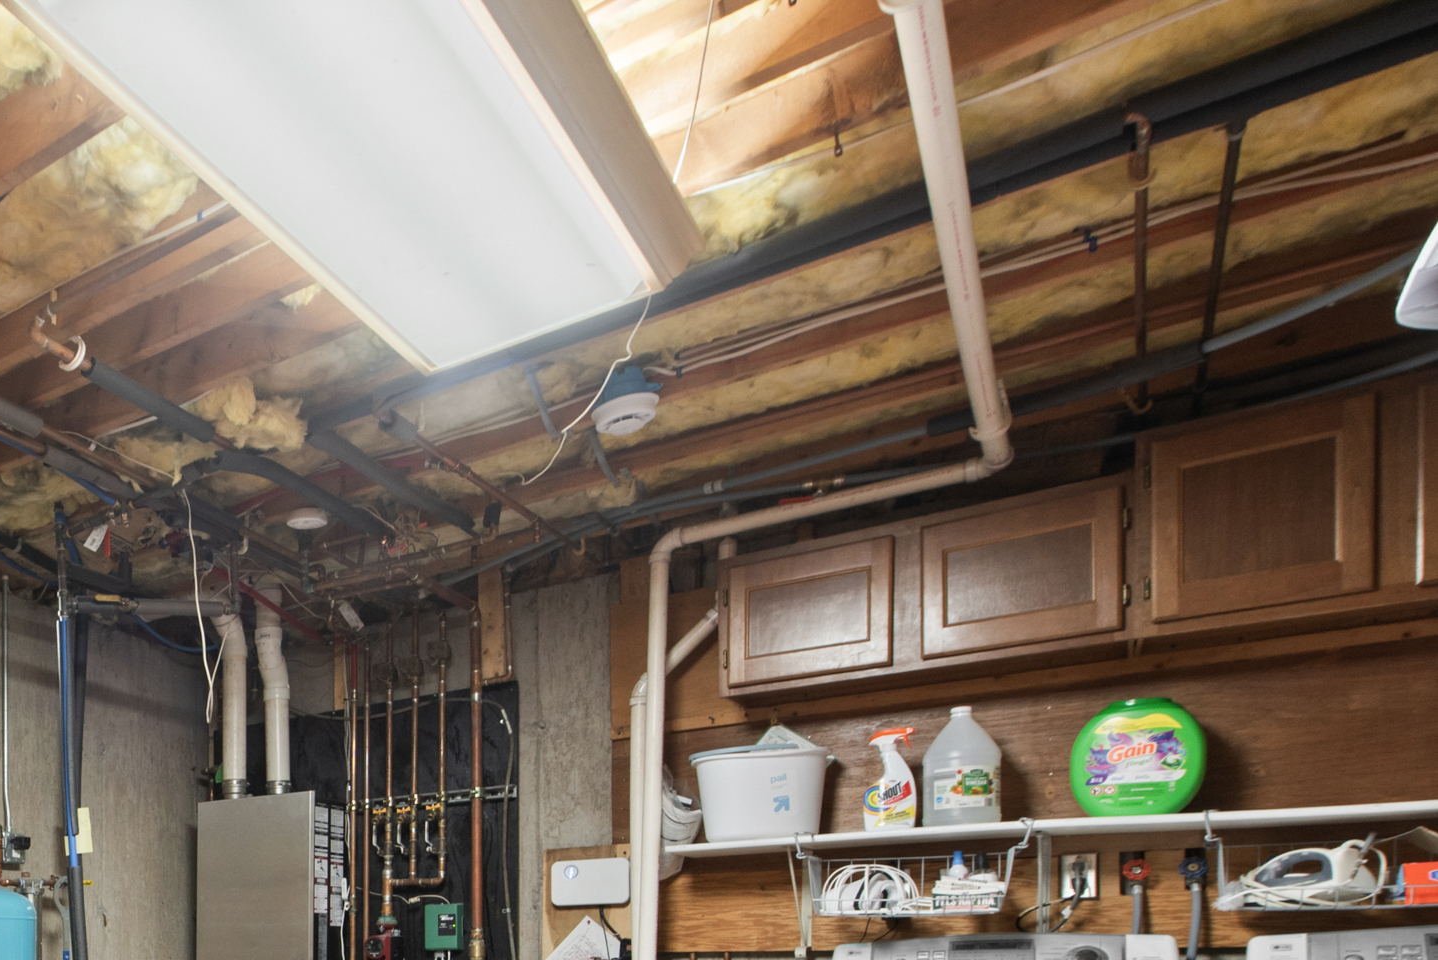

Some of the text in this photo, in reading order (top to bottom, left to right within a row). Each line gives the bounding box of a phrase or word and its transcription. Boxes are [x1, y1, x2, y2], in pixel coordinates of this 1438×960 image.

[1108, 742, 1155, 763] Gain
[770, 773, 787, 784] pail
[877, 781, 902, 802] SHOUT
